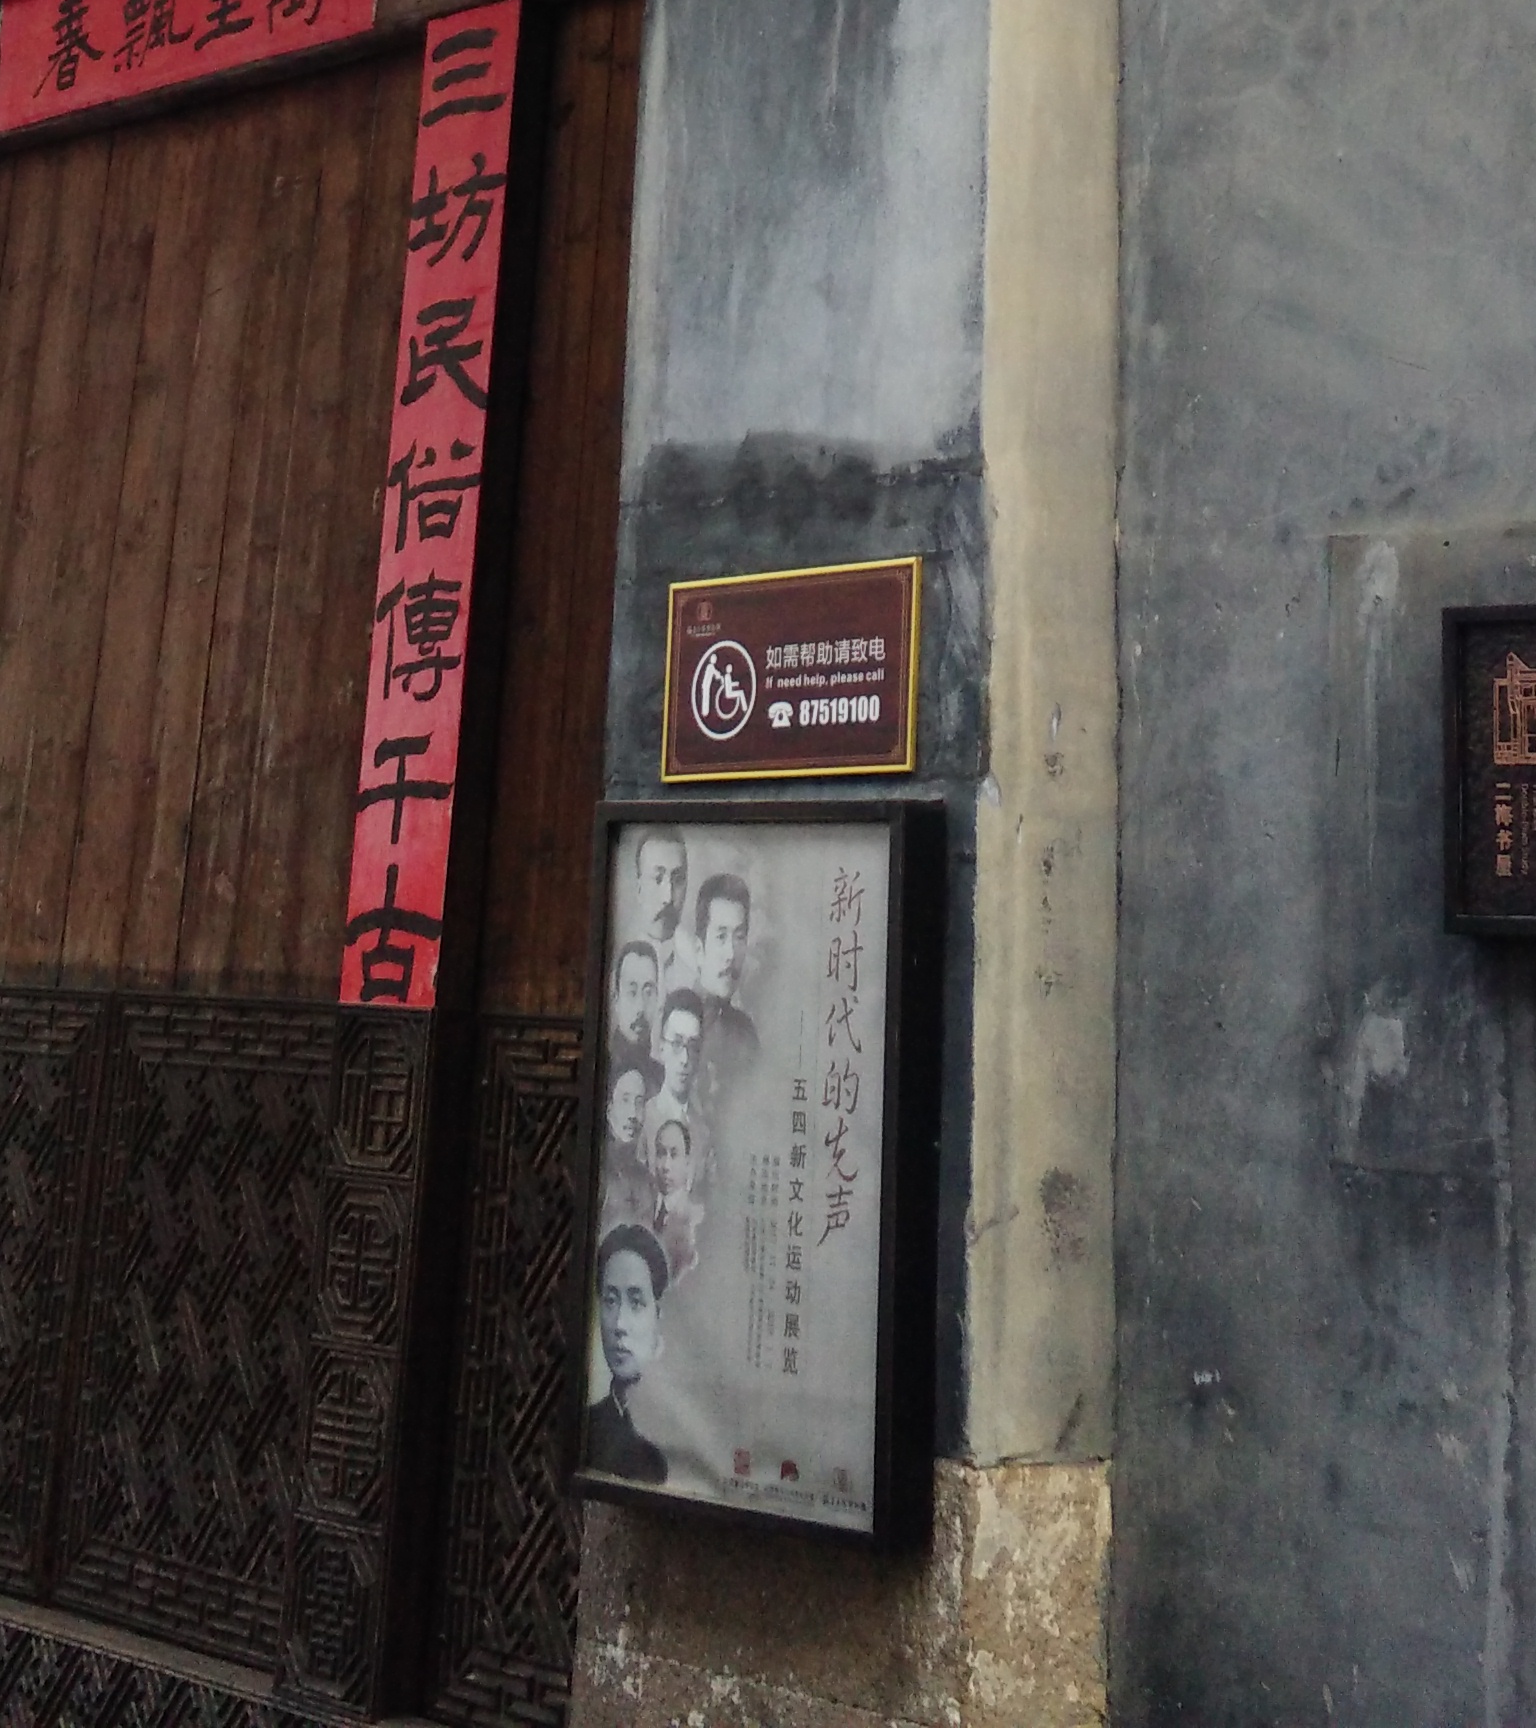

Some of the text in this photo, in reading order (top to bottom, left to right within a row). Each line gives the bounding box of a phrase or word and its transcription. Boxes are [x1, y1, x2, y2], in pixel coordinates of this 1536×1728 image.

[765, 636, 886, 670] 如需帮助请致电
[765, 668, 884, 689] If need help, please call
[799, 694, 880, 726] 87519100
[818, 865, 866, 1247] 新时代的先声
